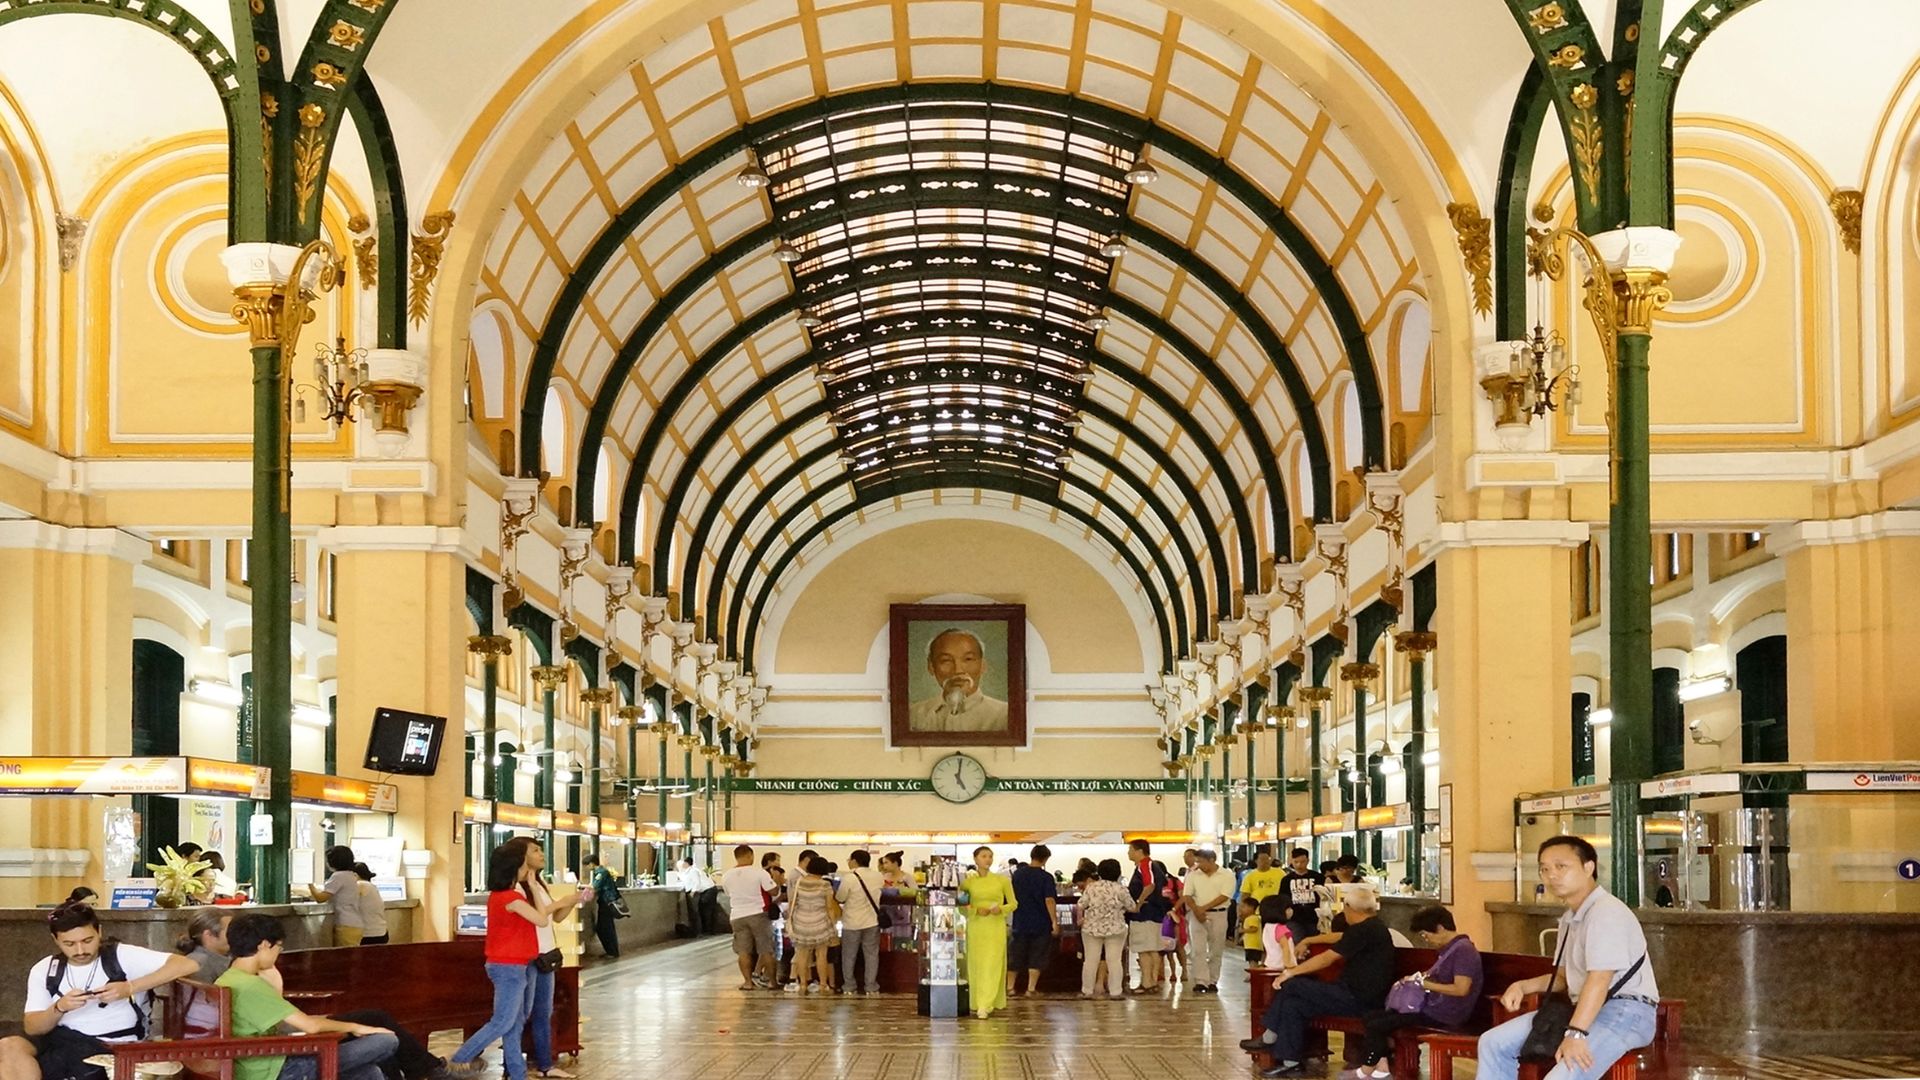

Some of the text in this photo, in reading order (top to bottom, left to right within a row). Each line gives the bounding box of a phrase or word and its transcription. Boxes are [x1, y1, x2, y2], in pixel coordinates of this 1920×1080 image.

[755, 779, 839, 790] NHANH CHÓNG
[853, 779, 921, 790] CHÍNH XÁC
[997, 779, 1164, 791] AN TOÀN TIỆN LỢI VĂN MINH
[1660, 864, 1666, 876] 2
[1906, 863, 1913, 876] 1
